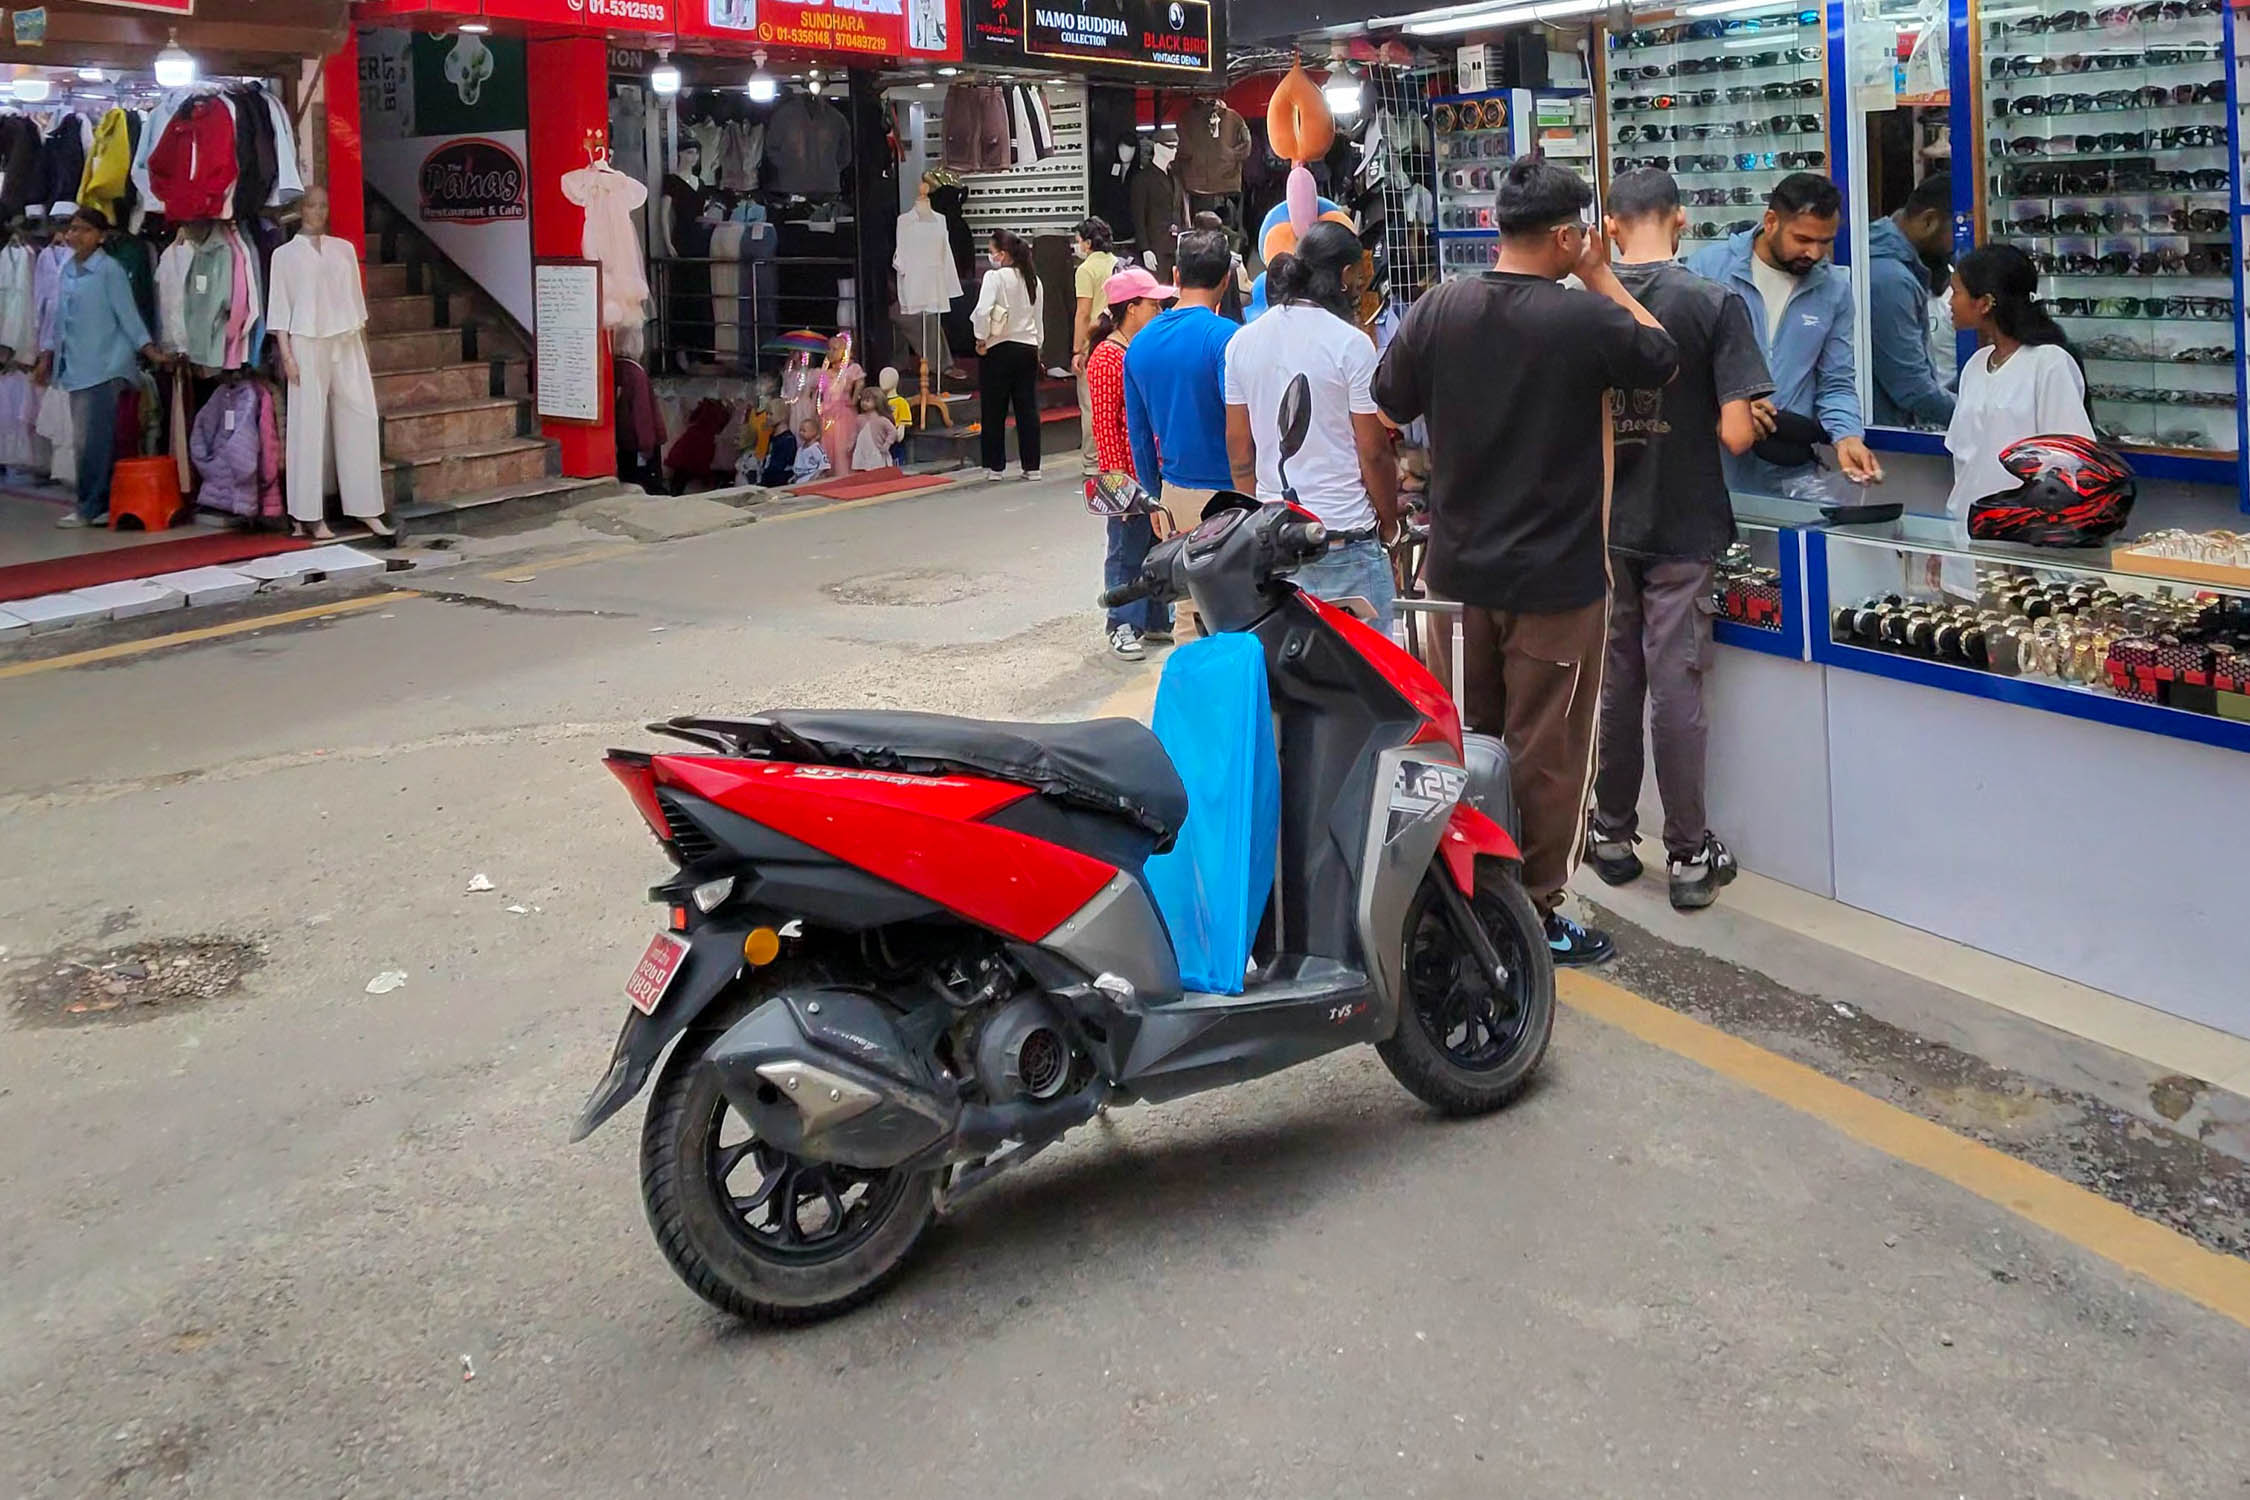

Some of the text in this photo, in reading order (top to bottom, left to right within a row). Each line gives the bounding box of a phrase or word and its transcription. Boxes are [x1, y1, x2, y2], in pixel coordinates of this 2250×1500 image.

[589, 0, 665, 21] 01-5312593
[800, 11, 865, 32] SUNDHARA
[1035, 9, 1075, 30] NAMO
[1077, 14, 1128, 37] BUDDHA
[835, 32, 887, 51] 9704897219
[1061, 31, 1107, 47] COLLECTION
[1143, 31, 1181, 52] BLACK
[1183, 35, 1208, 54] BIRD
[607, 48, 642, 68] ION
[1152, 51, 1201, 66] VINTAGE DENIM
[382, 54, 397, 111] BEST
[423, 163, 518, 202] Panas
[423, 204, 523, 218] Restaurant & Cafe
[1415, 768, 1465, 804] 125
[1329, 1003, 1353, 1020] TVS
